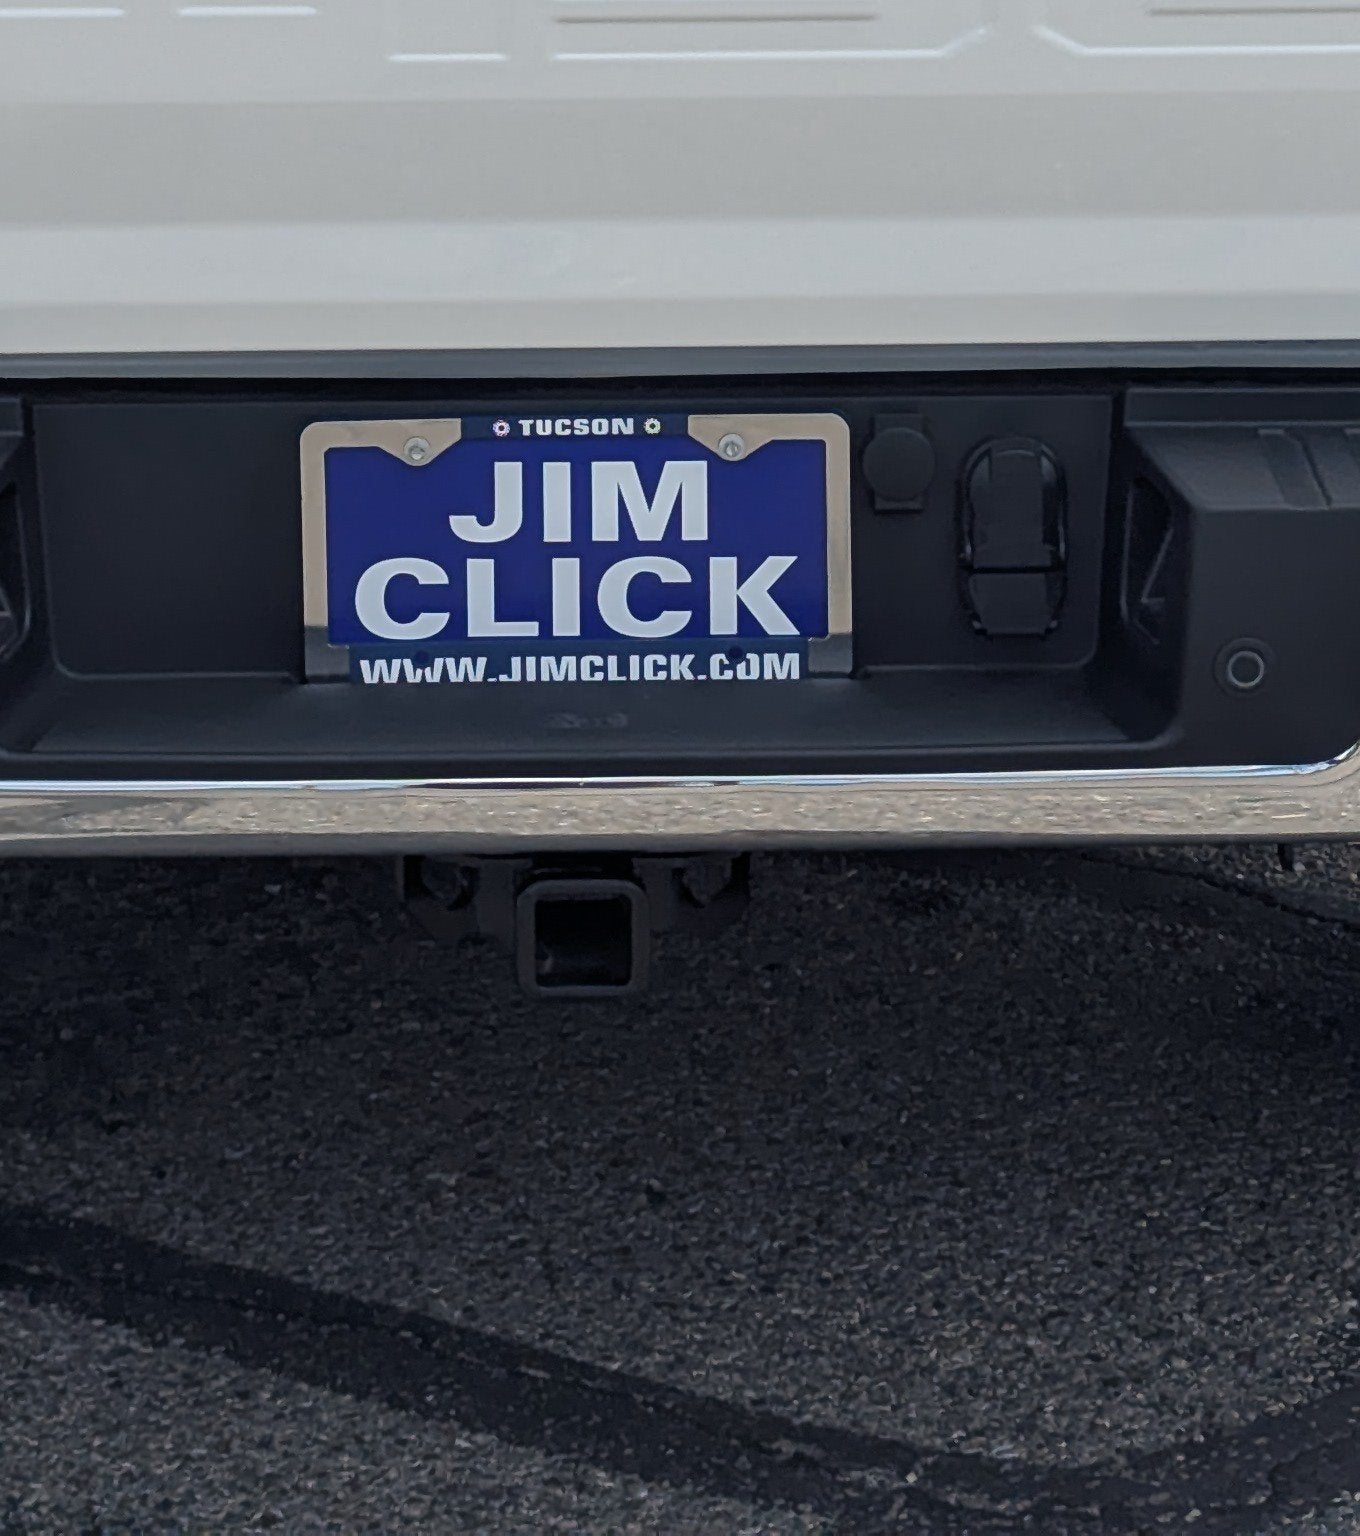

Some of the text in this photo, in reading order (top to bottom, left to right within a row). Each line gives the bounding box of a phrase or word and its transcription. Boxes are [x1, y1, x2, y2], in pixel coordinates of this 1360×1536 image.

[518, 417, 635, 437] TUCSON
[448, 460, 709, 543] JIM
[354, 555, 801, 640] CLICK
[359, 652, 801, 684] WWW.JIMCLICK.COM
